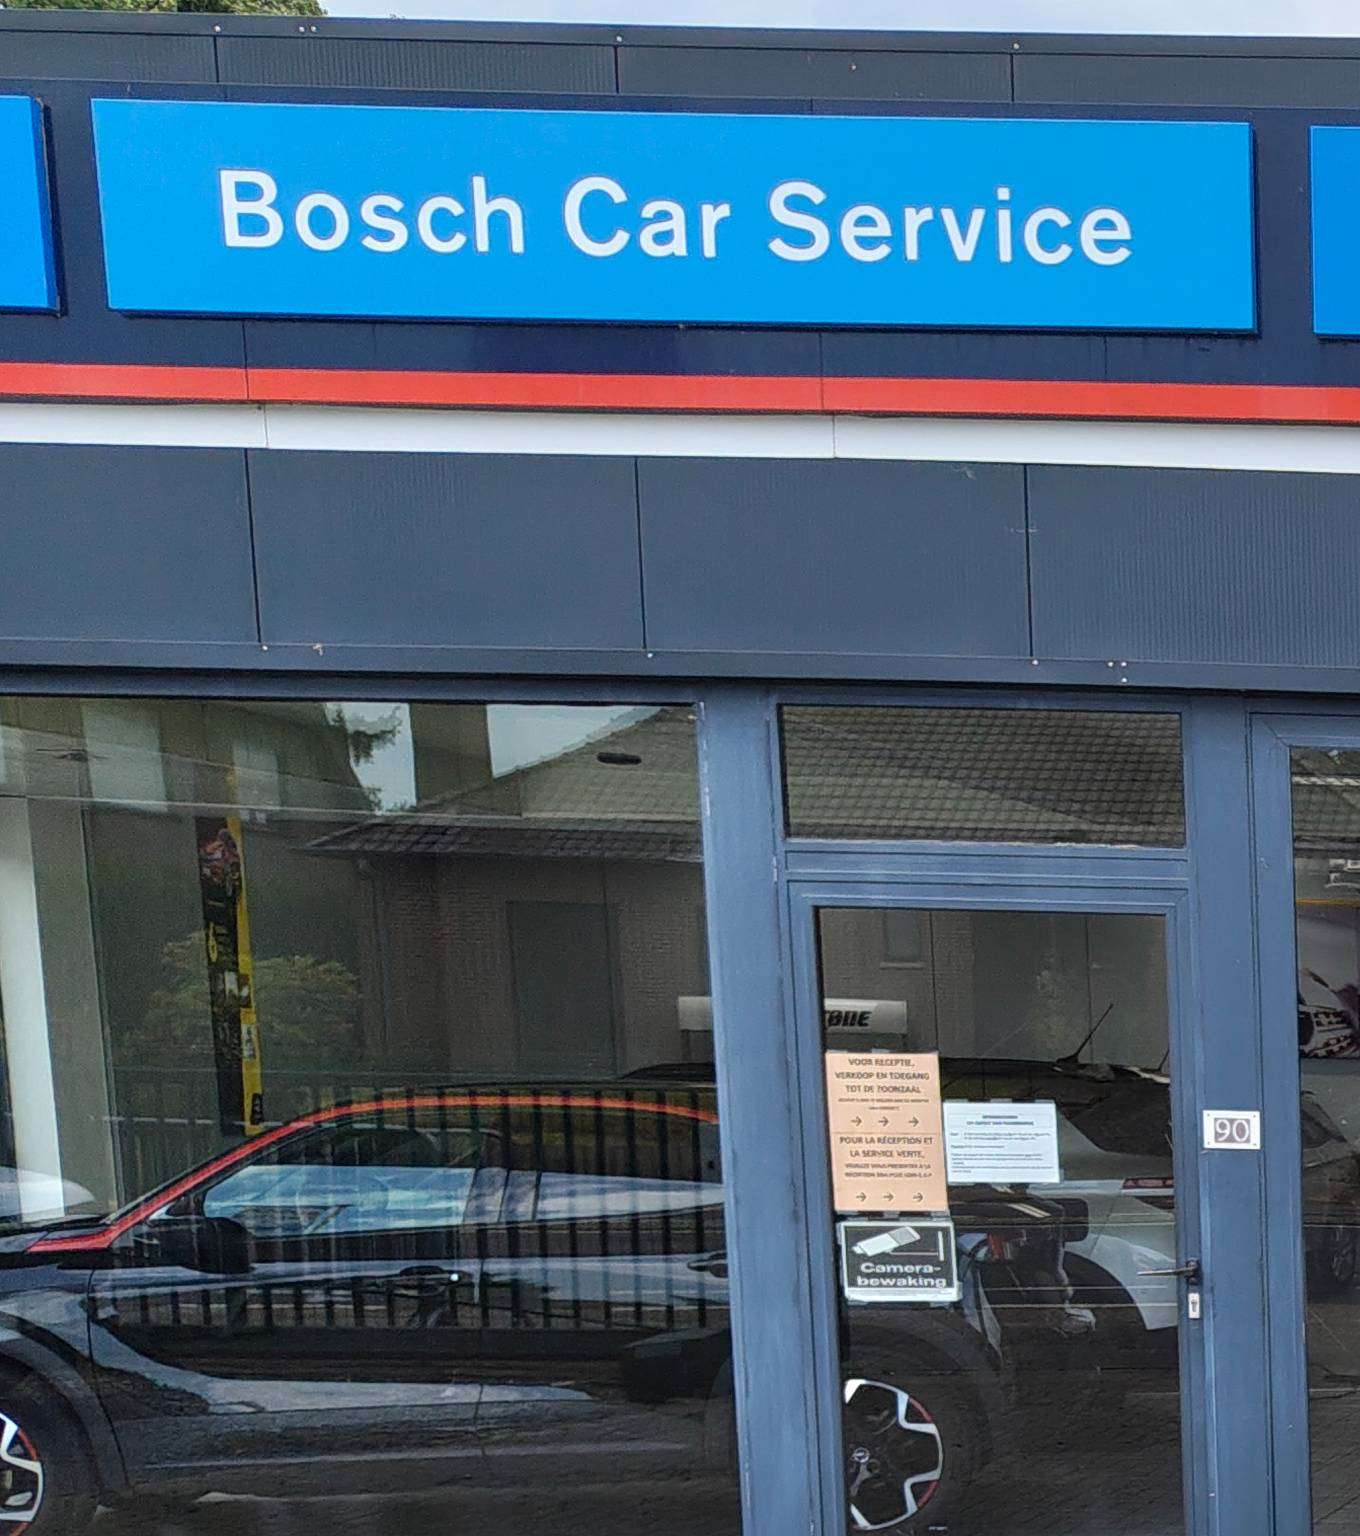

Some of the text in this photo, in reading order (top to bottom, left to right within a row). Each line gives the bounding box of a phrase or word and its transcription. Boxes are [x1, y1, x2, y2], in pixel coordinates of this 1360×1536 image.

[220, 169, 1132, 266] Bosch Car Service
[889, 1071, 930, 1081] TOEGANG
[845, 1084, 861, 1093] TOT
[1214, 1119, 1250, 1143] 90
[839, 1136, 864, 1145] POUR
[865, 1136, 876, 1145] LA
[849, 1149, 861, 1158] LA
[860, 1261, 942, 1275] Camera-
[856, 1274, 948, 1289] bewaking
